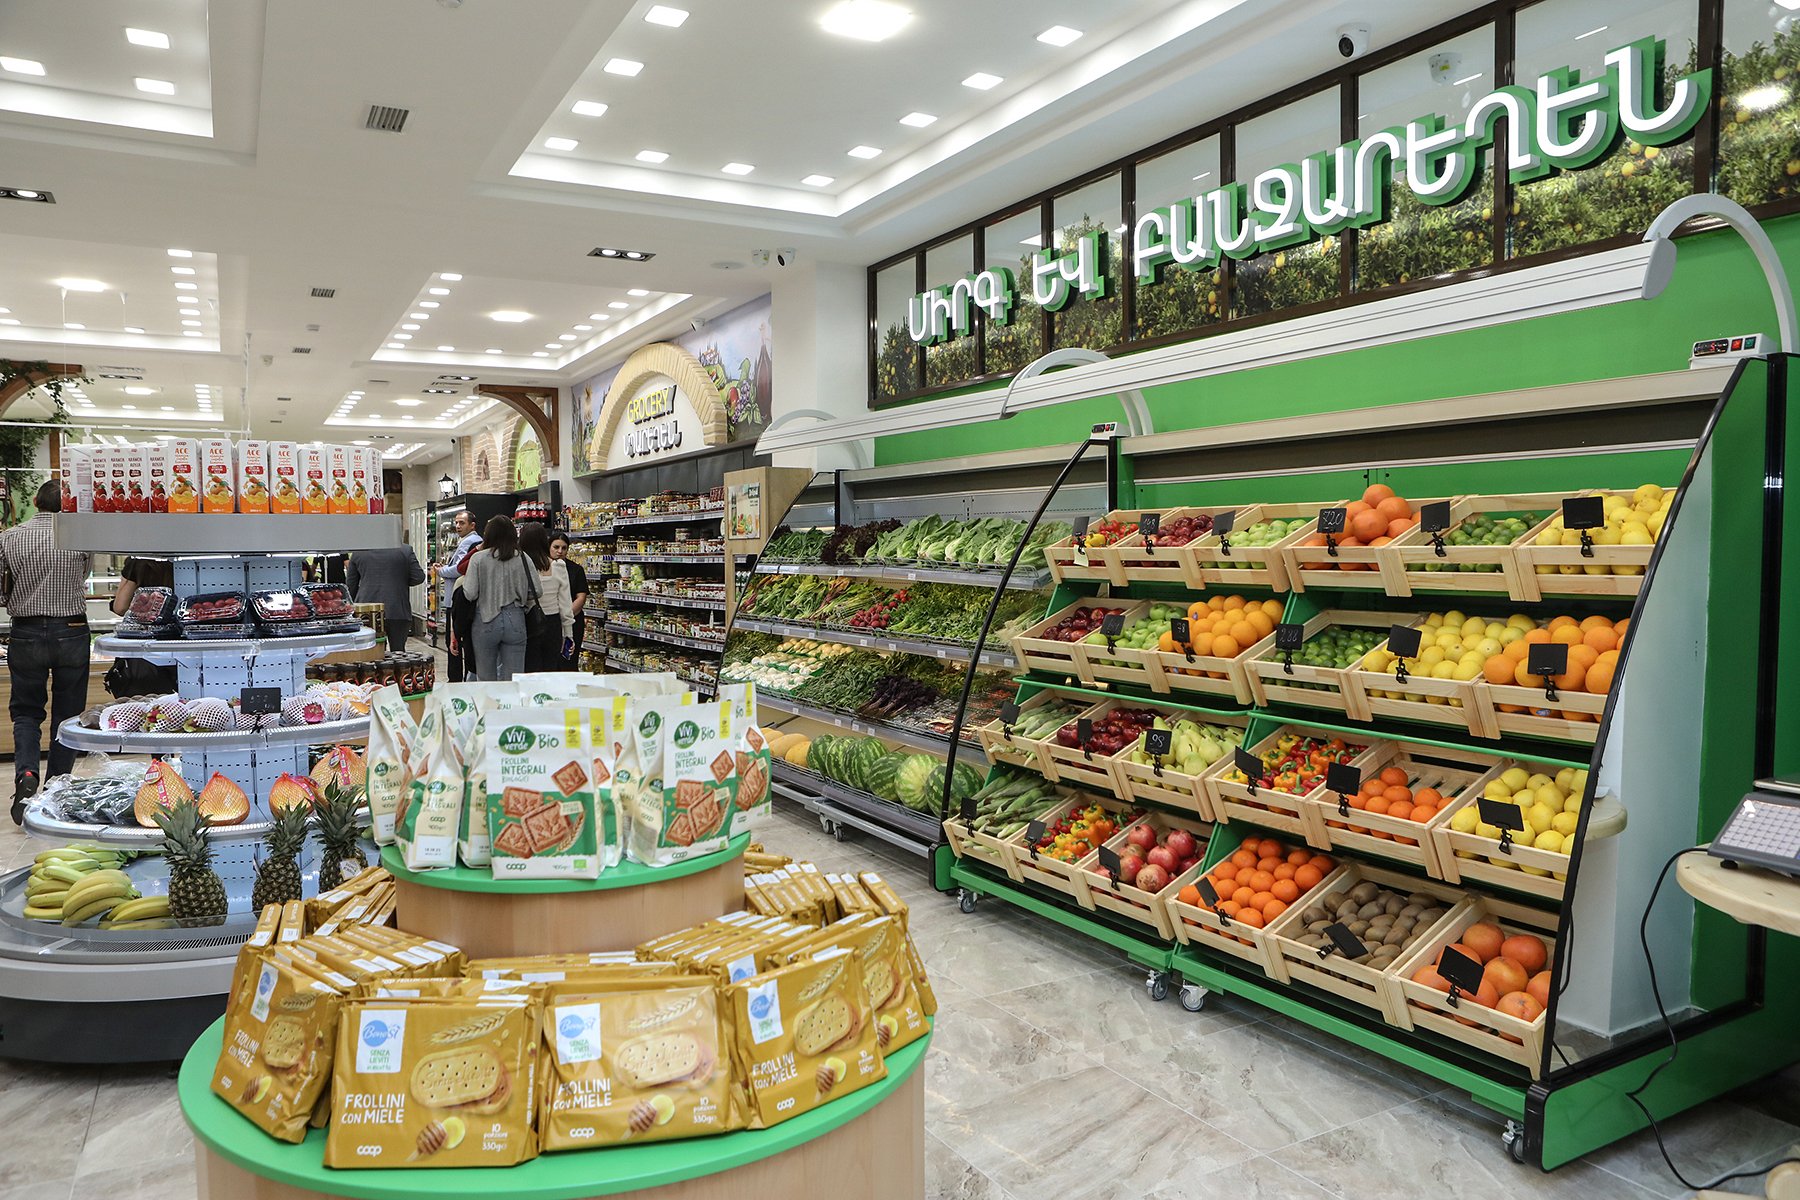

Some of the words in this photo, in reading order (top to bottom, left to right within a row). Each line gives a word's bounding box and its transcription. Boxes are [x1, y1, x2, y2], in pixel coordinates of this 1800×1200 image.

[628, 386, 674, 424] GROCERY
[538, 733, 560, 749] Bio
[701, 726, 716, 741] Bio
[501, 757, 530, 765] FROLLINI
[675, 756, 707, 769] INTEGRALI
[501, 764, 546, 775] INTEGRALI
[234, 1029, 260, 1055] FROLLINI
[752, 1051, 795, 1076] FROLLINI
[770, 1064, 798, 1087] MIELE
[344, 1093, 406, 1109] FROLLINI
[573, 1093, 612, 1108] MIELE
[341, 1113, 361, 1124] CON
[363, 1109, 404, 1124] MIELE
[491, 1123, 501, 1133] 10
